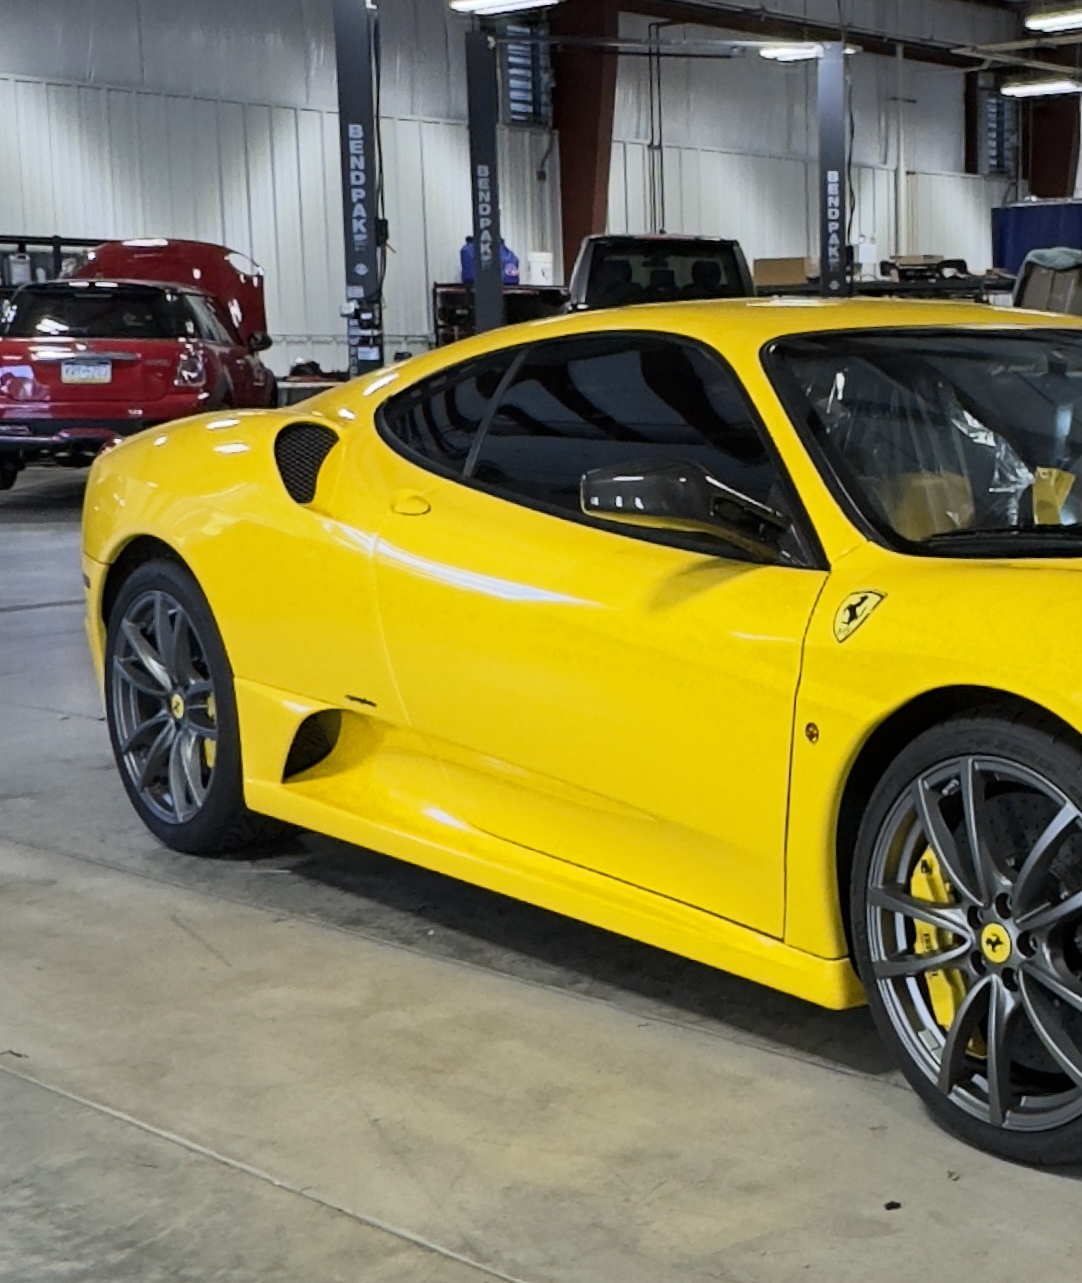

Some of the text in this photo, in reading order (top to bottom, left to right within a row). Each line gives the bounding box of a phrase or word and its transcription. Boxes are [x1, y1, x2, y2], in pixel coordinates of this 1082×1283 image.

[348, 123, 367, 233] BENDPAK
[477, 165, 492, 254] BENDPAK
[827, 171, 840, 258] BENDPAK
